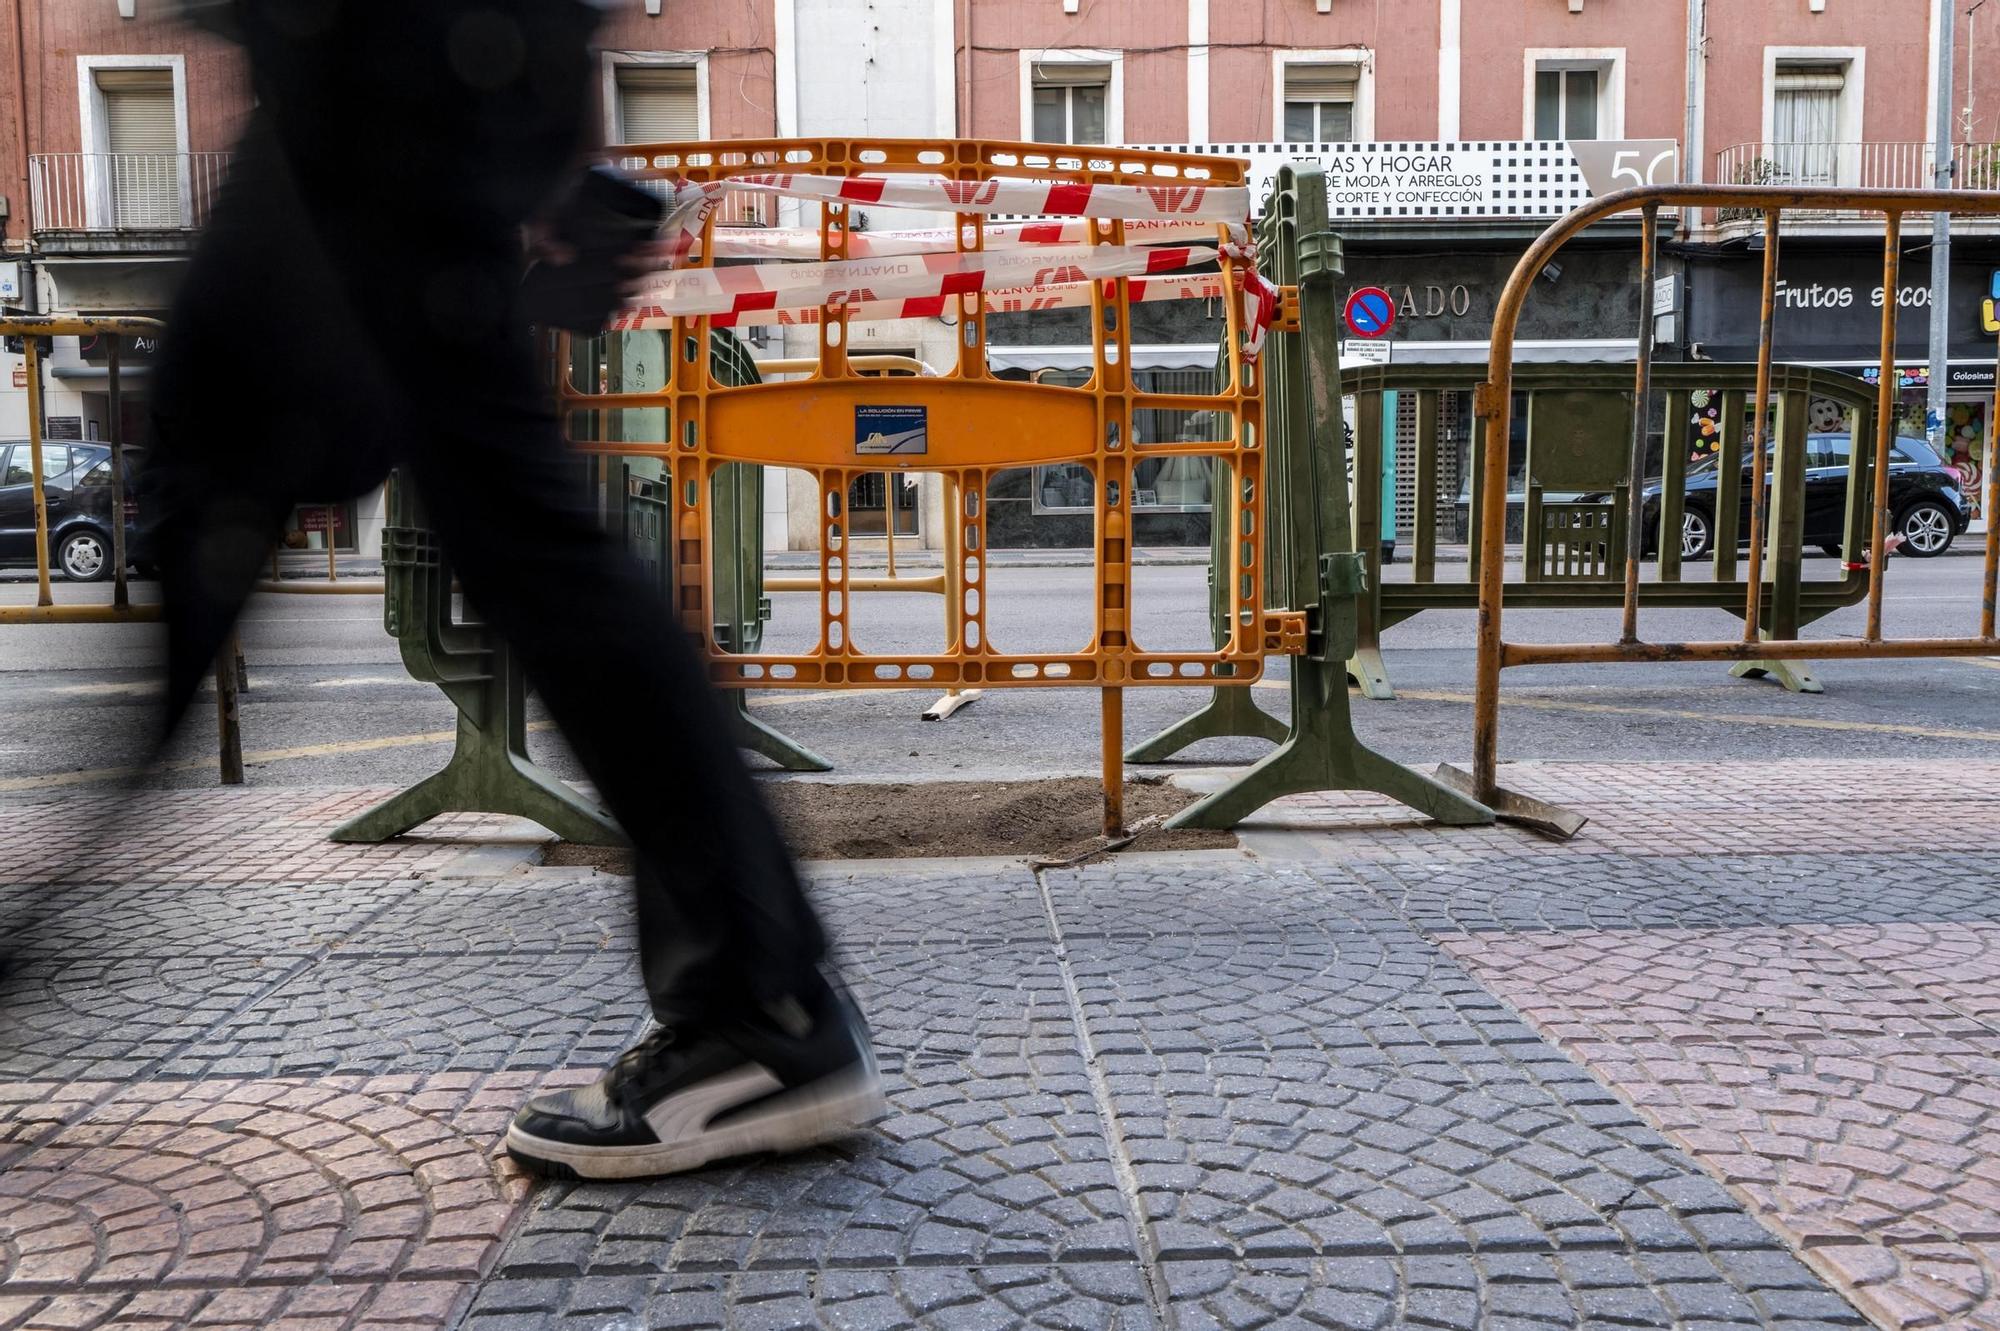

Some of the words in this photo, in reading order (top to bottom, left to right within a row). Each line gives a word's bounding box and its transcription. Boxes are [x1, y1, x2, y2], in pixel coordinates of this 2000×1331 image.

[1362, 156, 1374, 172] Y
[1381, 156, 1453, 172] HOGAR
[1346, 175, 1390, 188] MODA
[1395, 175, 1404, 187] Y
[1409, 174, 1482, 187] ARREGLOS
[1335, 191, 1380, 203] CORTE
[1383, 191, 1392, 202] Y
[1396, 188, 1483, 203] CONFECCIÓN
[1774, 279, 1853, 308] Frutos
[1871, 286, 1933, 308] sco
[1953, 371, 1994, 381] Golosinas
